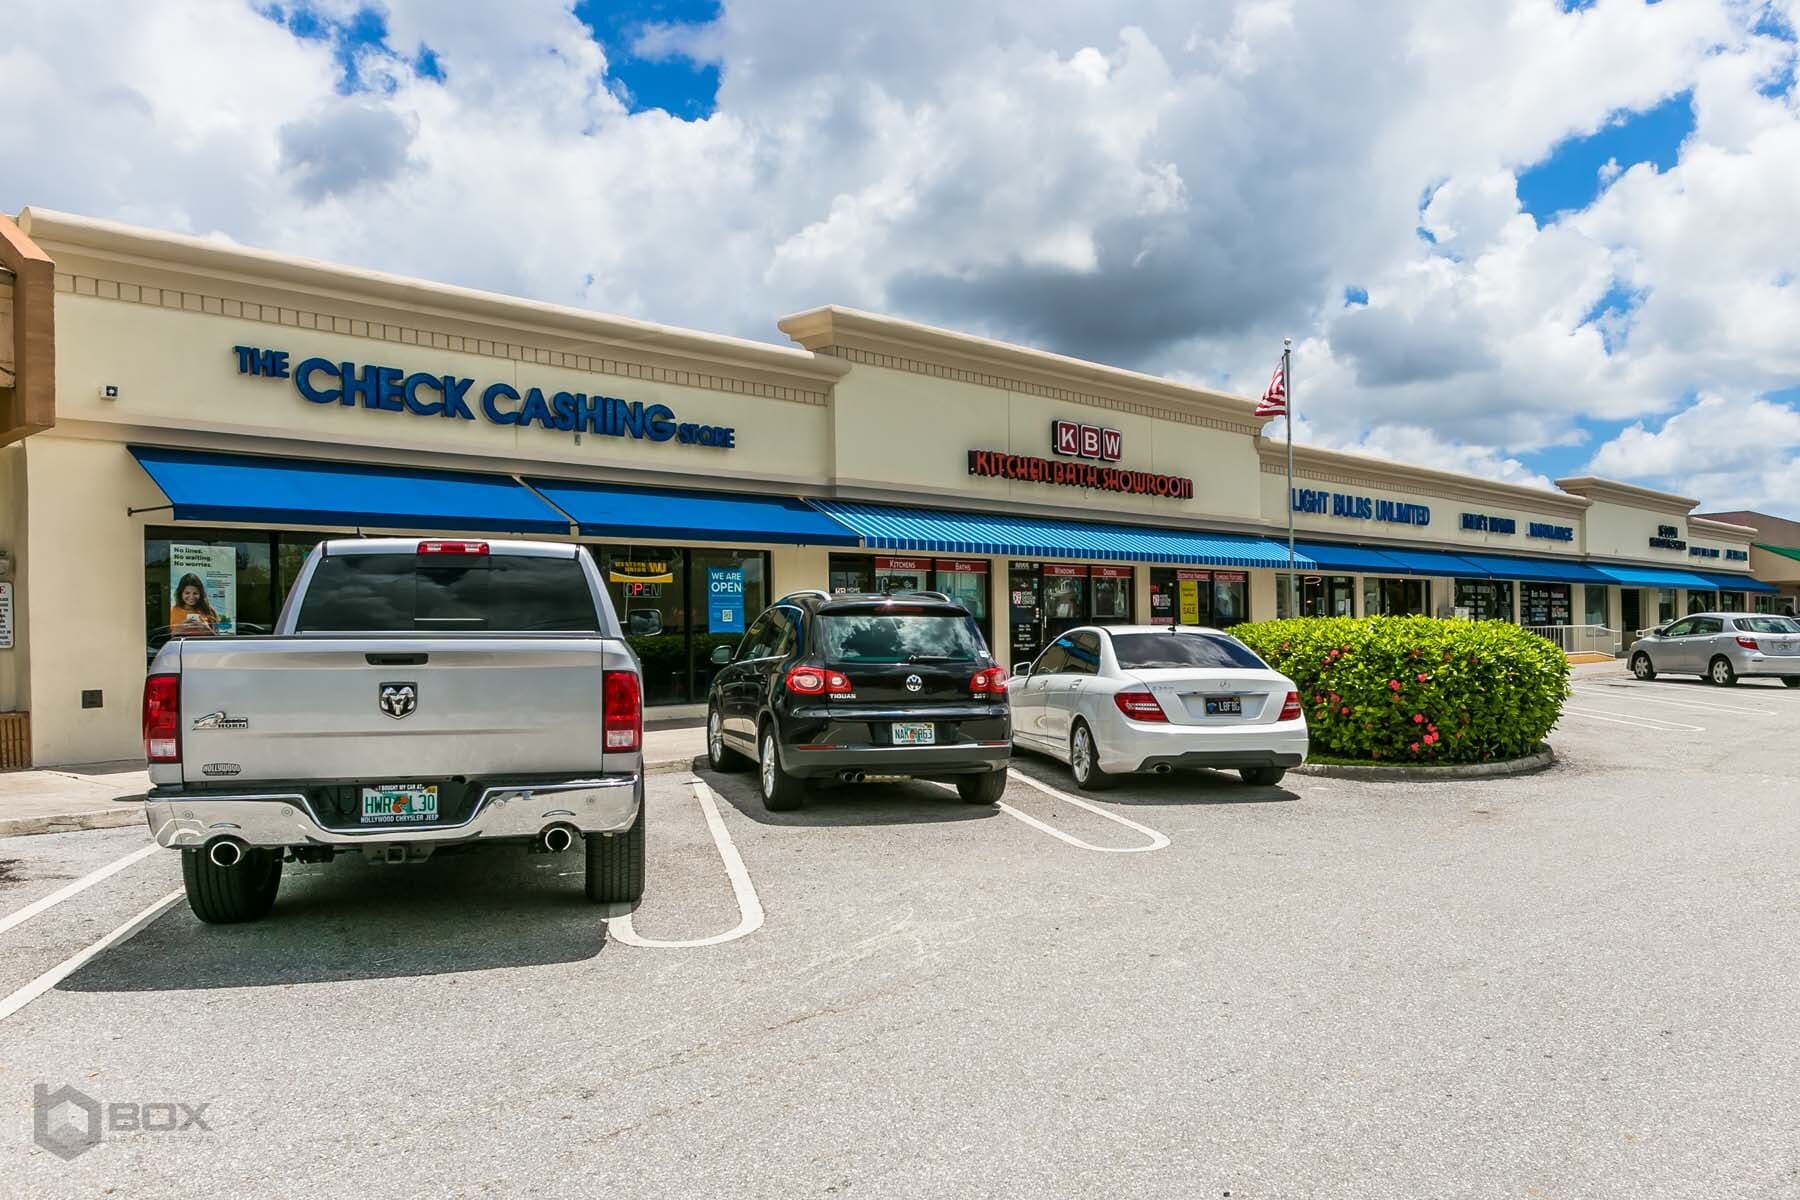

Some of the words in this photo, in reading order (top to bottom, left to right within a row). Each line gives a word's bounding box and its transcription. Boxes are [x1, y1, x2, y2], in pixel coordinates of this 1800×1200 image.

[232, 345, 290, 378] THE
[293, 357, 477, 421] CHECK
[480, 382, 678, 443] CASHING
[675, 422, 736, 449] STORE
[1058, 423, 1121, 459] KBW
[974, 450, 1050, 484] KITCHEN
[1052, 460, 1098, 487] BATH
[1101, 467, 1194, 499] SHOWROOM
[1291, 487, 1330, 514] LIGHT
[1333, 493, 1373, 520] BULBS
[1375, 499, 1431, 527] UNLIMITED
[711, 572, 725, 581] WE
[726, 572, 741, 581] ARE
[626, 583, 660, 597] OPEN
[710, 582, 742, 593] OPEN
[365, 796, 391, 813] HWR
[360, 815, 395, 823] HOLLYWOOD
[395, 814, 424, 822] CHRYSLER
